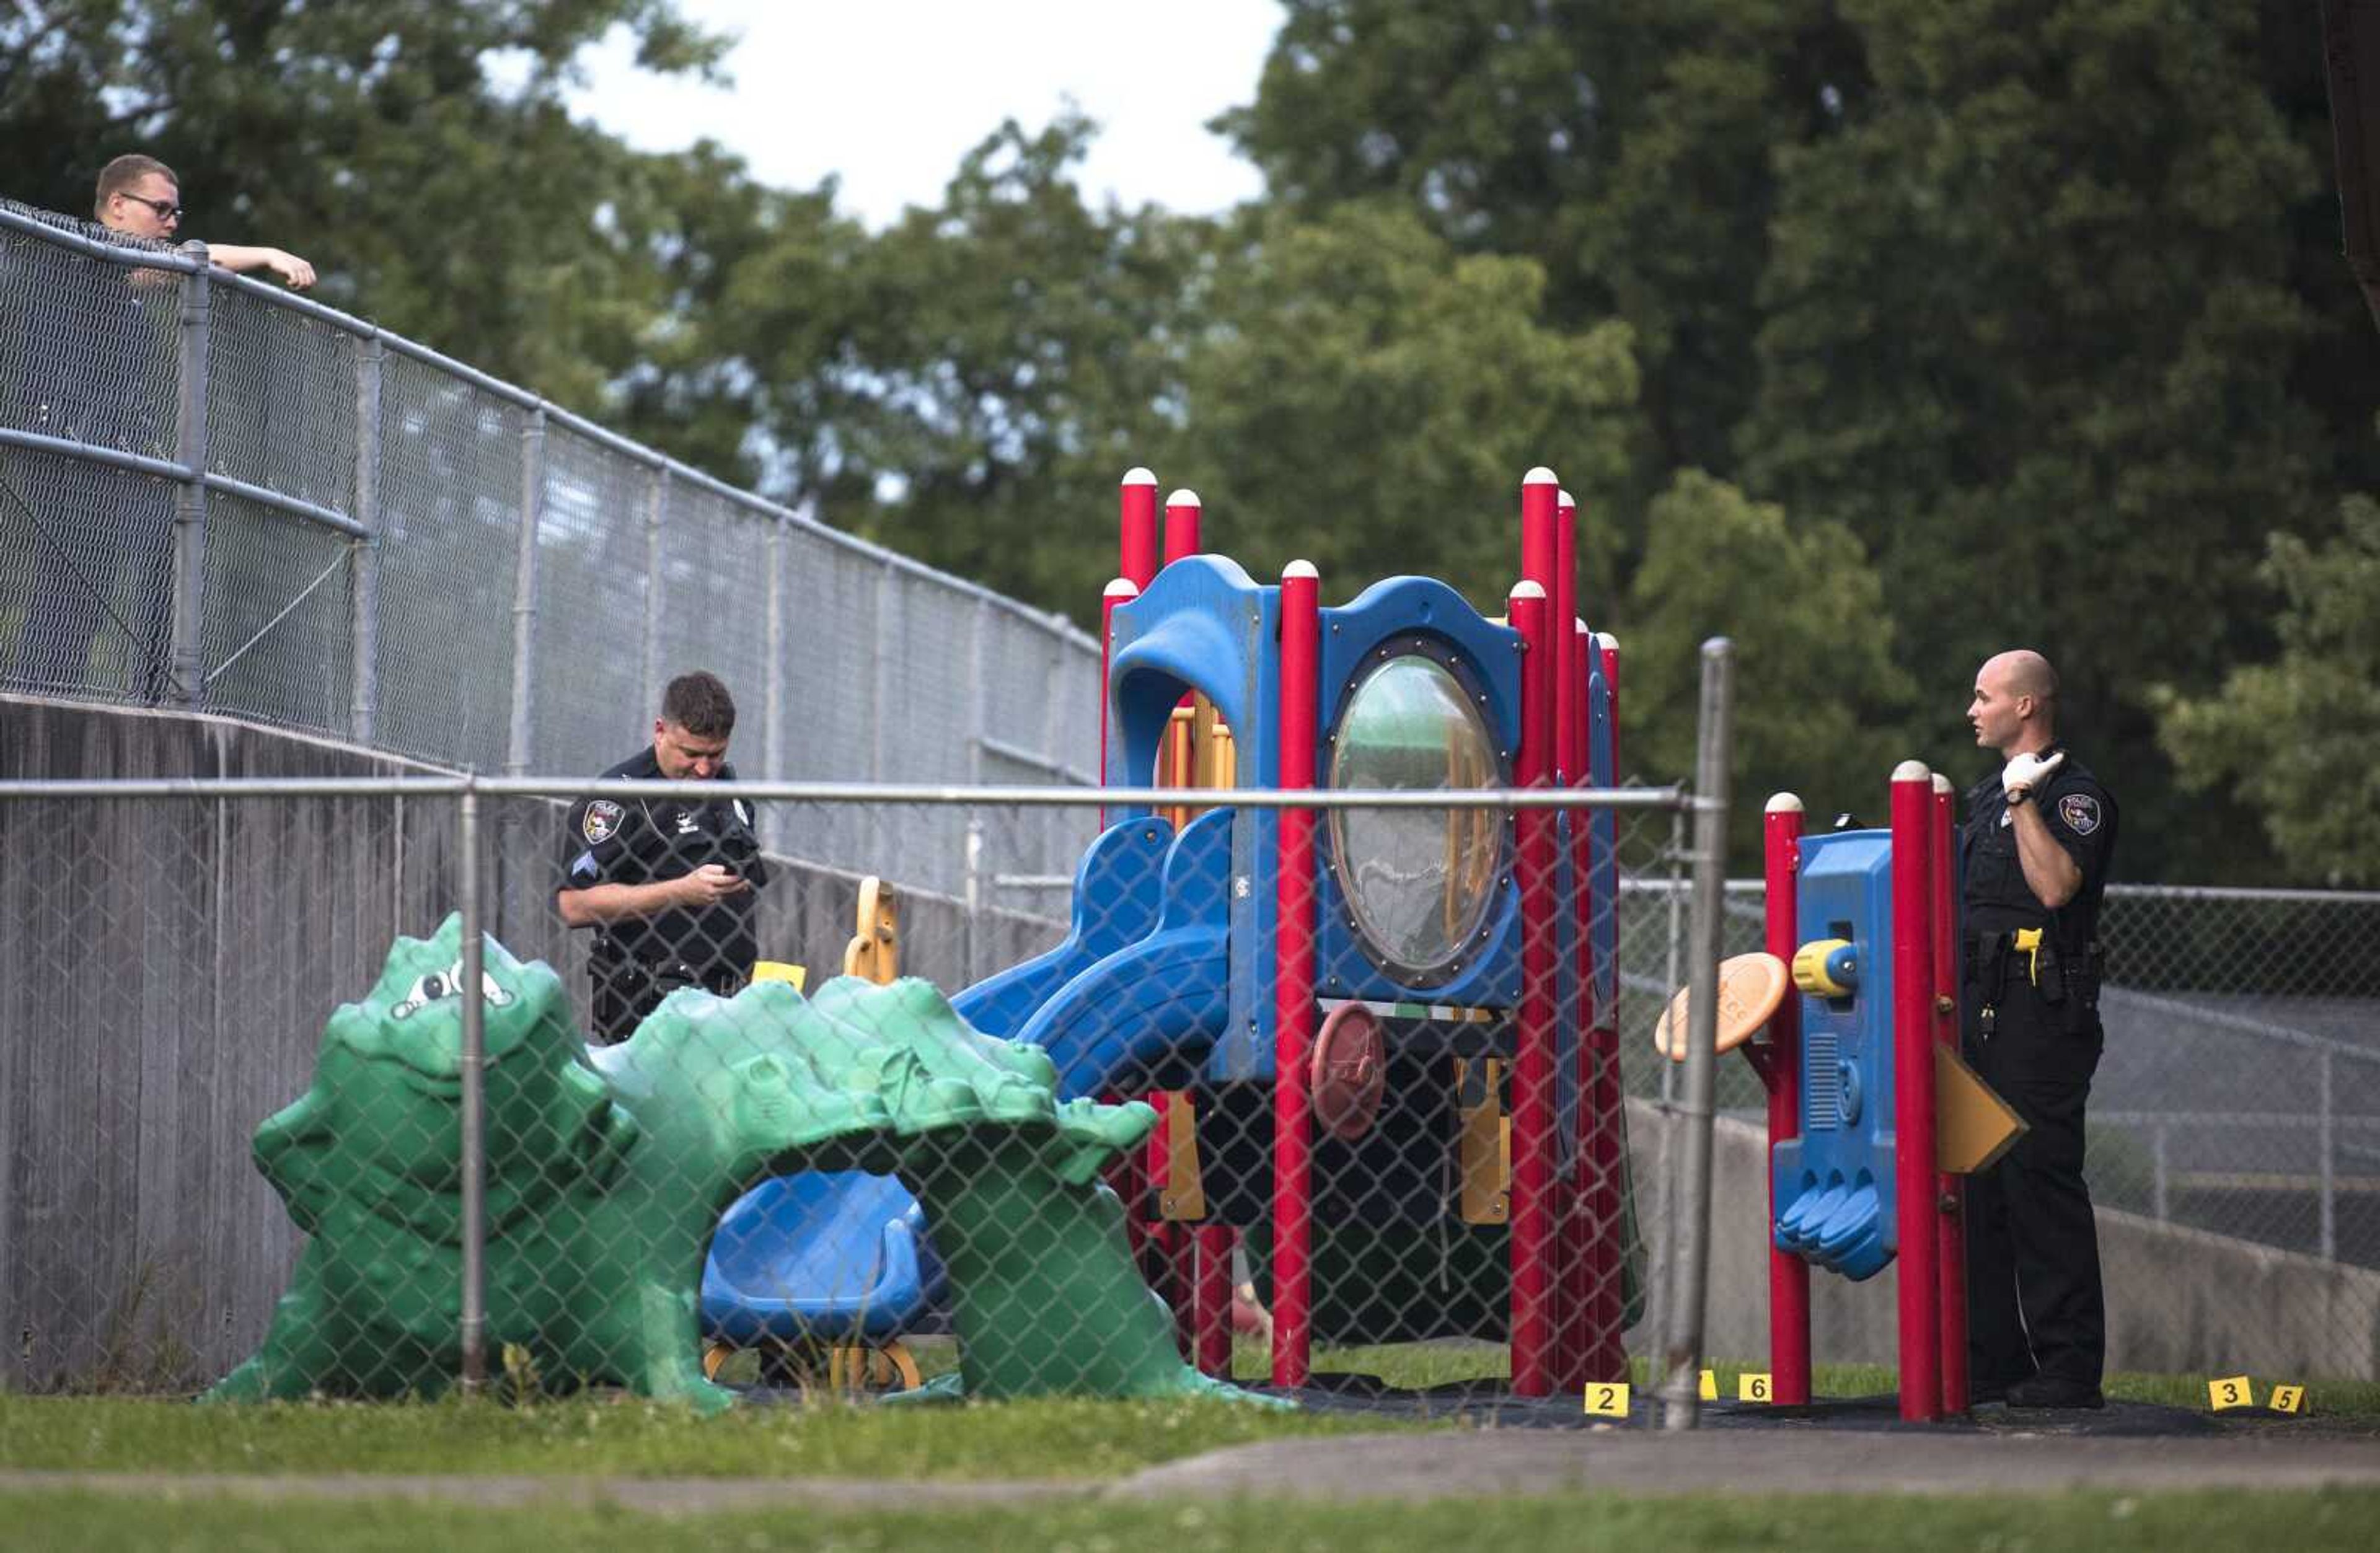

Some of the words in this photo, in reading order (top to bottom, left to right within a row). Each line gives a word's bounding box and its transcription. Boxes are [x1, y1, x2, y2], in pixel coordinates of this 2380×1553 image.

[1751, 1379, 1765, 1397] 6
[2223, 1383, 2238, 1403] 3
[1599, 1388, 1614, 1409] 2
[2278, 1391, 2293, 1409] 5
